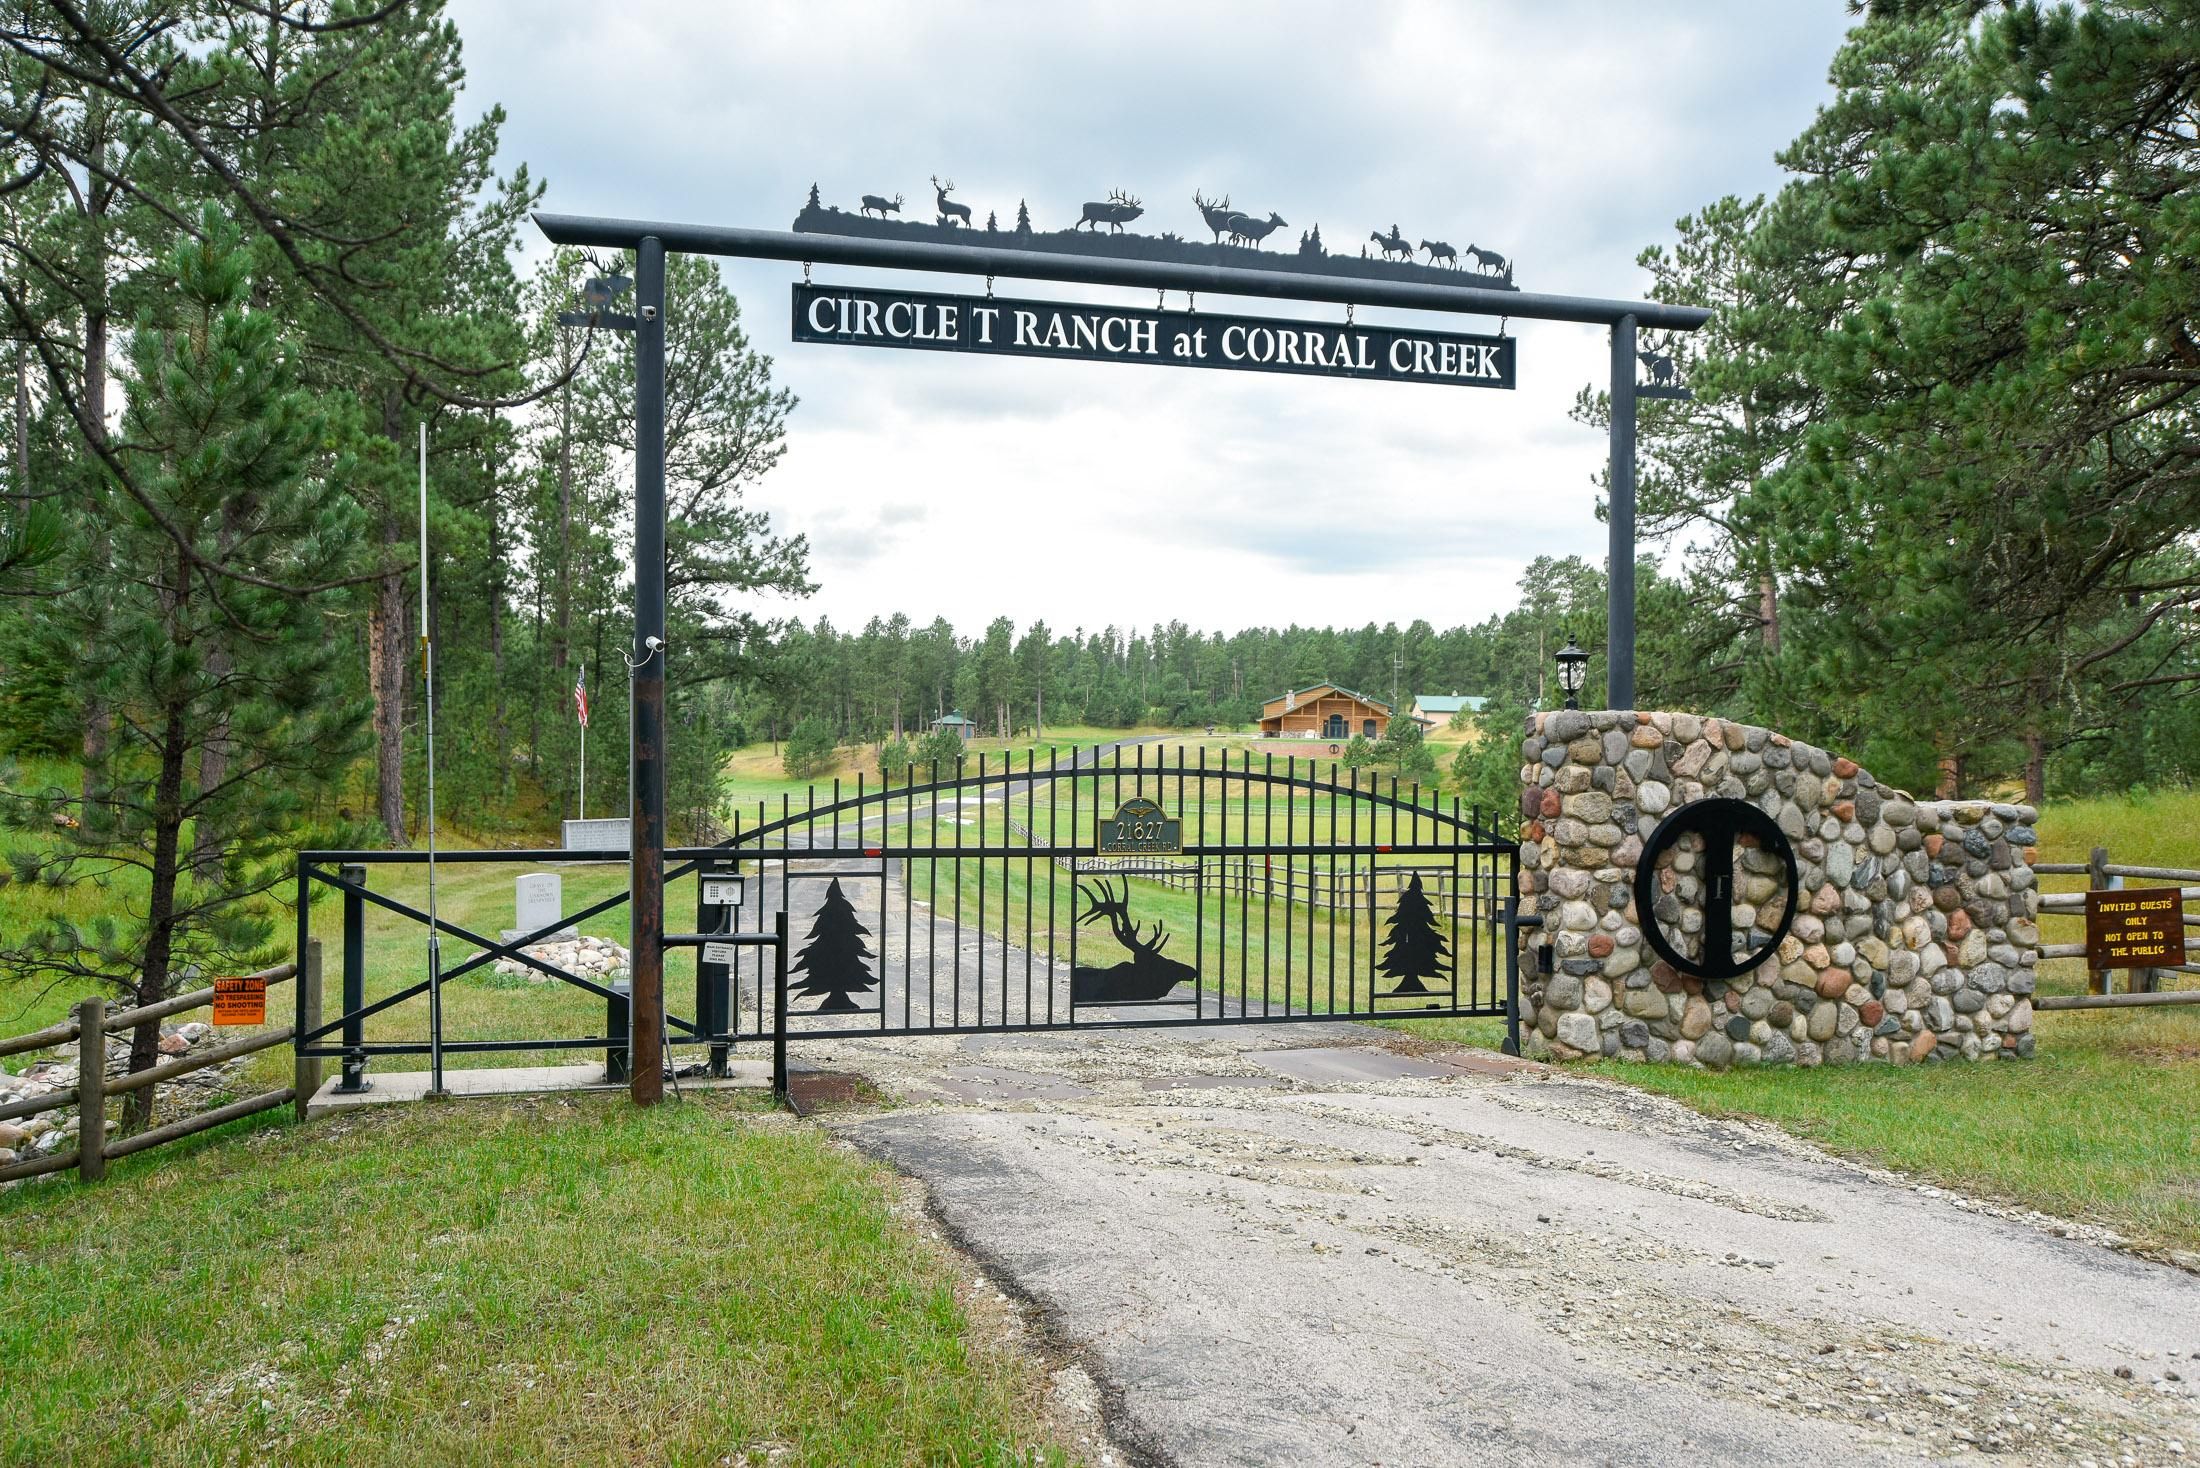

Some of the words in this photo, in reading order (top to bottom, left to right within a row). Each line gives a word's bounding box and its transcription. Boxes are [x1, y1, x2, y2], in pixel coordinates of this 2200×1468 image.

[808, 296, 959, 341] CIRCLE
[972, 307, 999, 343] T
[1014, 310, 1160, 354] RANCH
[1173, 327, 1208, 358] at
[1221, 326, 1376, 370] CORRAL
[1389, 338, 1502, 379] CREEK
[1117, 822, 1163, 840] 21827
[1139, 842, 1159, 852] CREEK
[2100, 902, 2136, 912] INVITED
[2140, 900, 2172, 910] GUESTS
[2125, 917, 2147, 926] ONLY
[2105, 933, 2121, 942] NOT
[2126, 932, 2148, 941] OPEN
[2152, 931, 2164, 940] TO
[2110, 947, 2128, 956] THE
[2132, 945, 2165, 956] PUBLIC
[216, 980, 243, 991] SAFETY
[245, 980, 264, 991] ZONE
